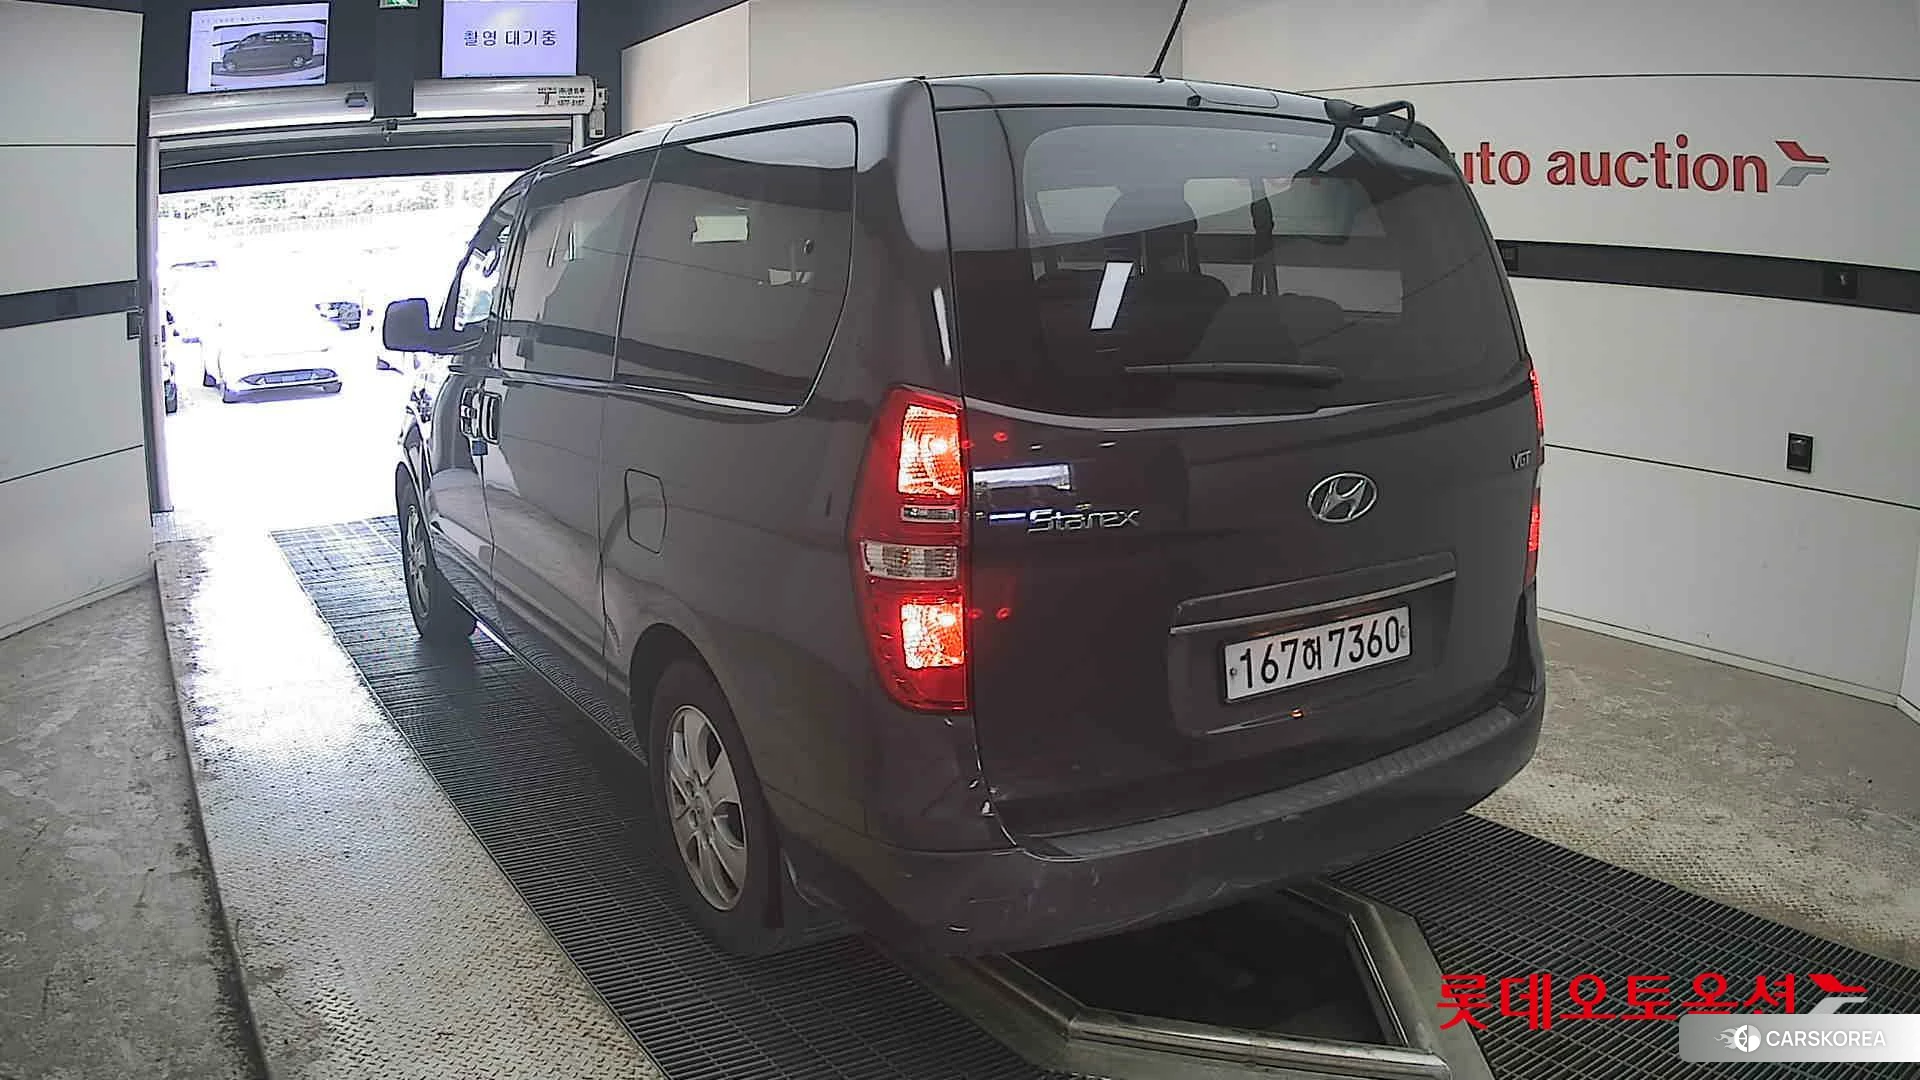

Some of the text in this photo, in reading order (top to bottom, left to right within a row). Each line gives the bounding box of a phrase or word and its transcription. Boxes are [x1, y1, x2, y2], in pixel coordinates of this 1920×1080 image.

[504, 30, 556, 46] 대기중
[1450, 134, 1768, 193] uto auction
[1027, 508, 1141, 533] Starex
